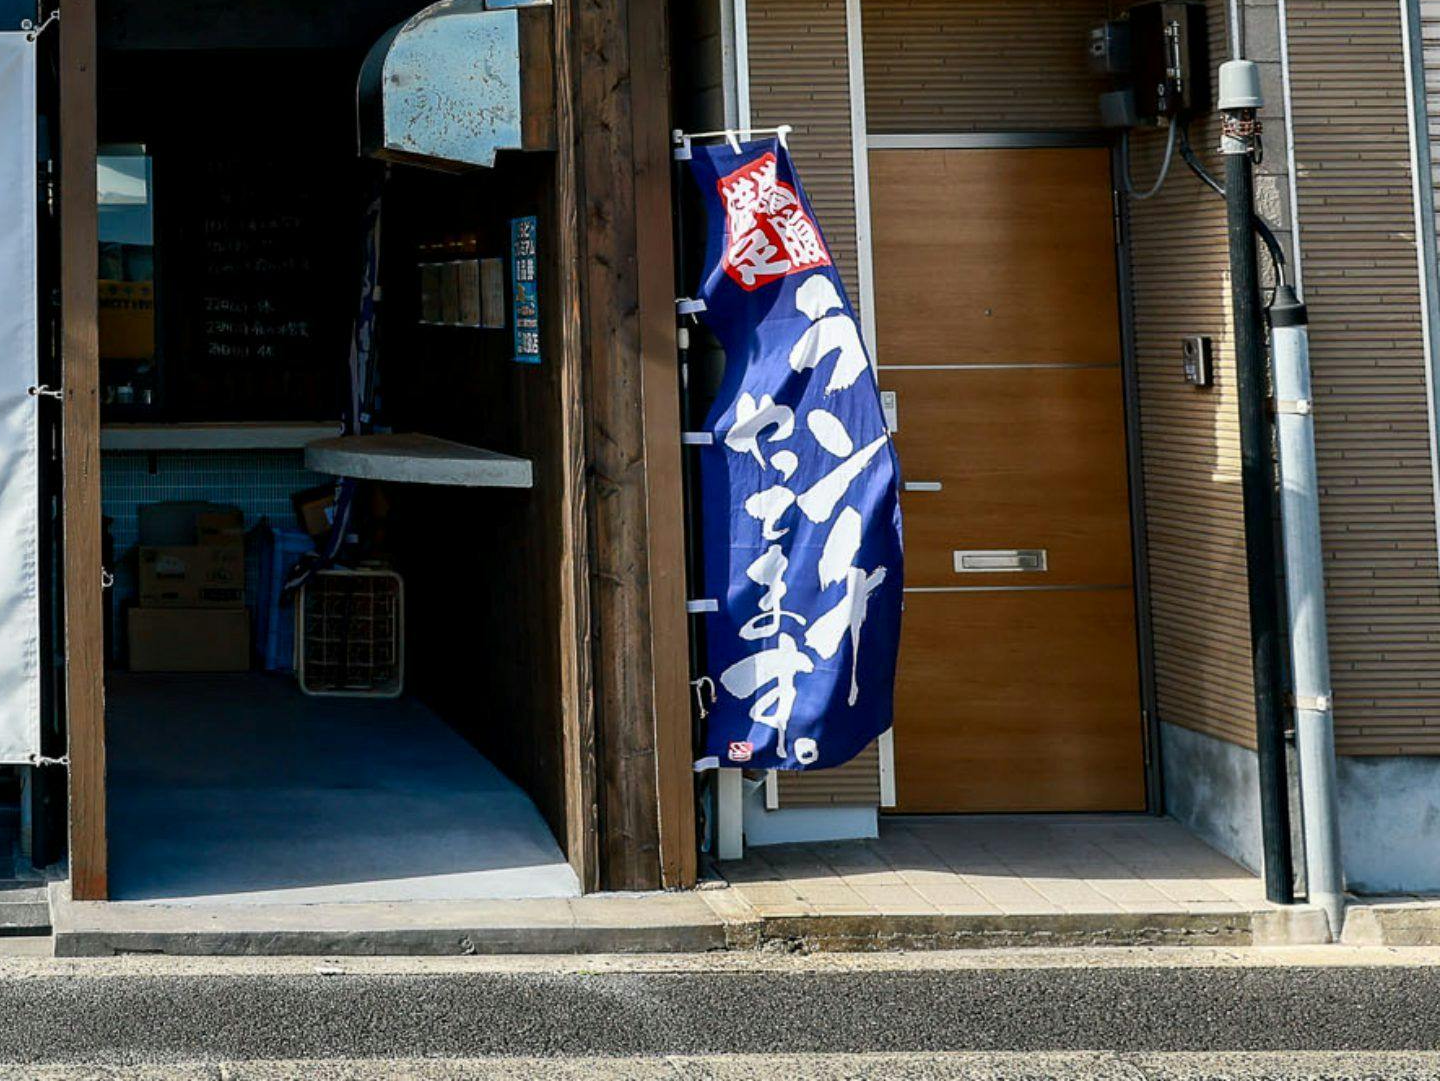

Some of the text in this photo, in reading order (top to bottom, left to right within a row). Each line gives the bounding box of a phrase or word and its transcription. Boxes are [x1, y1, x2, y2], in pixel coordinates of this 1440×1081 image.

[719, 390, 820, 766] やってます。
[789, 273, 890, 707] ランチ
